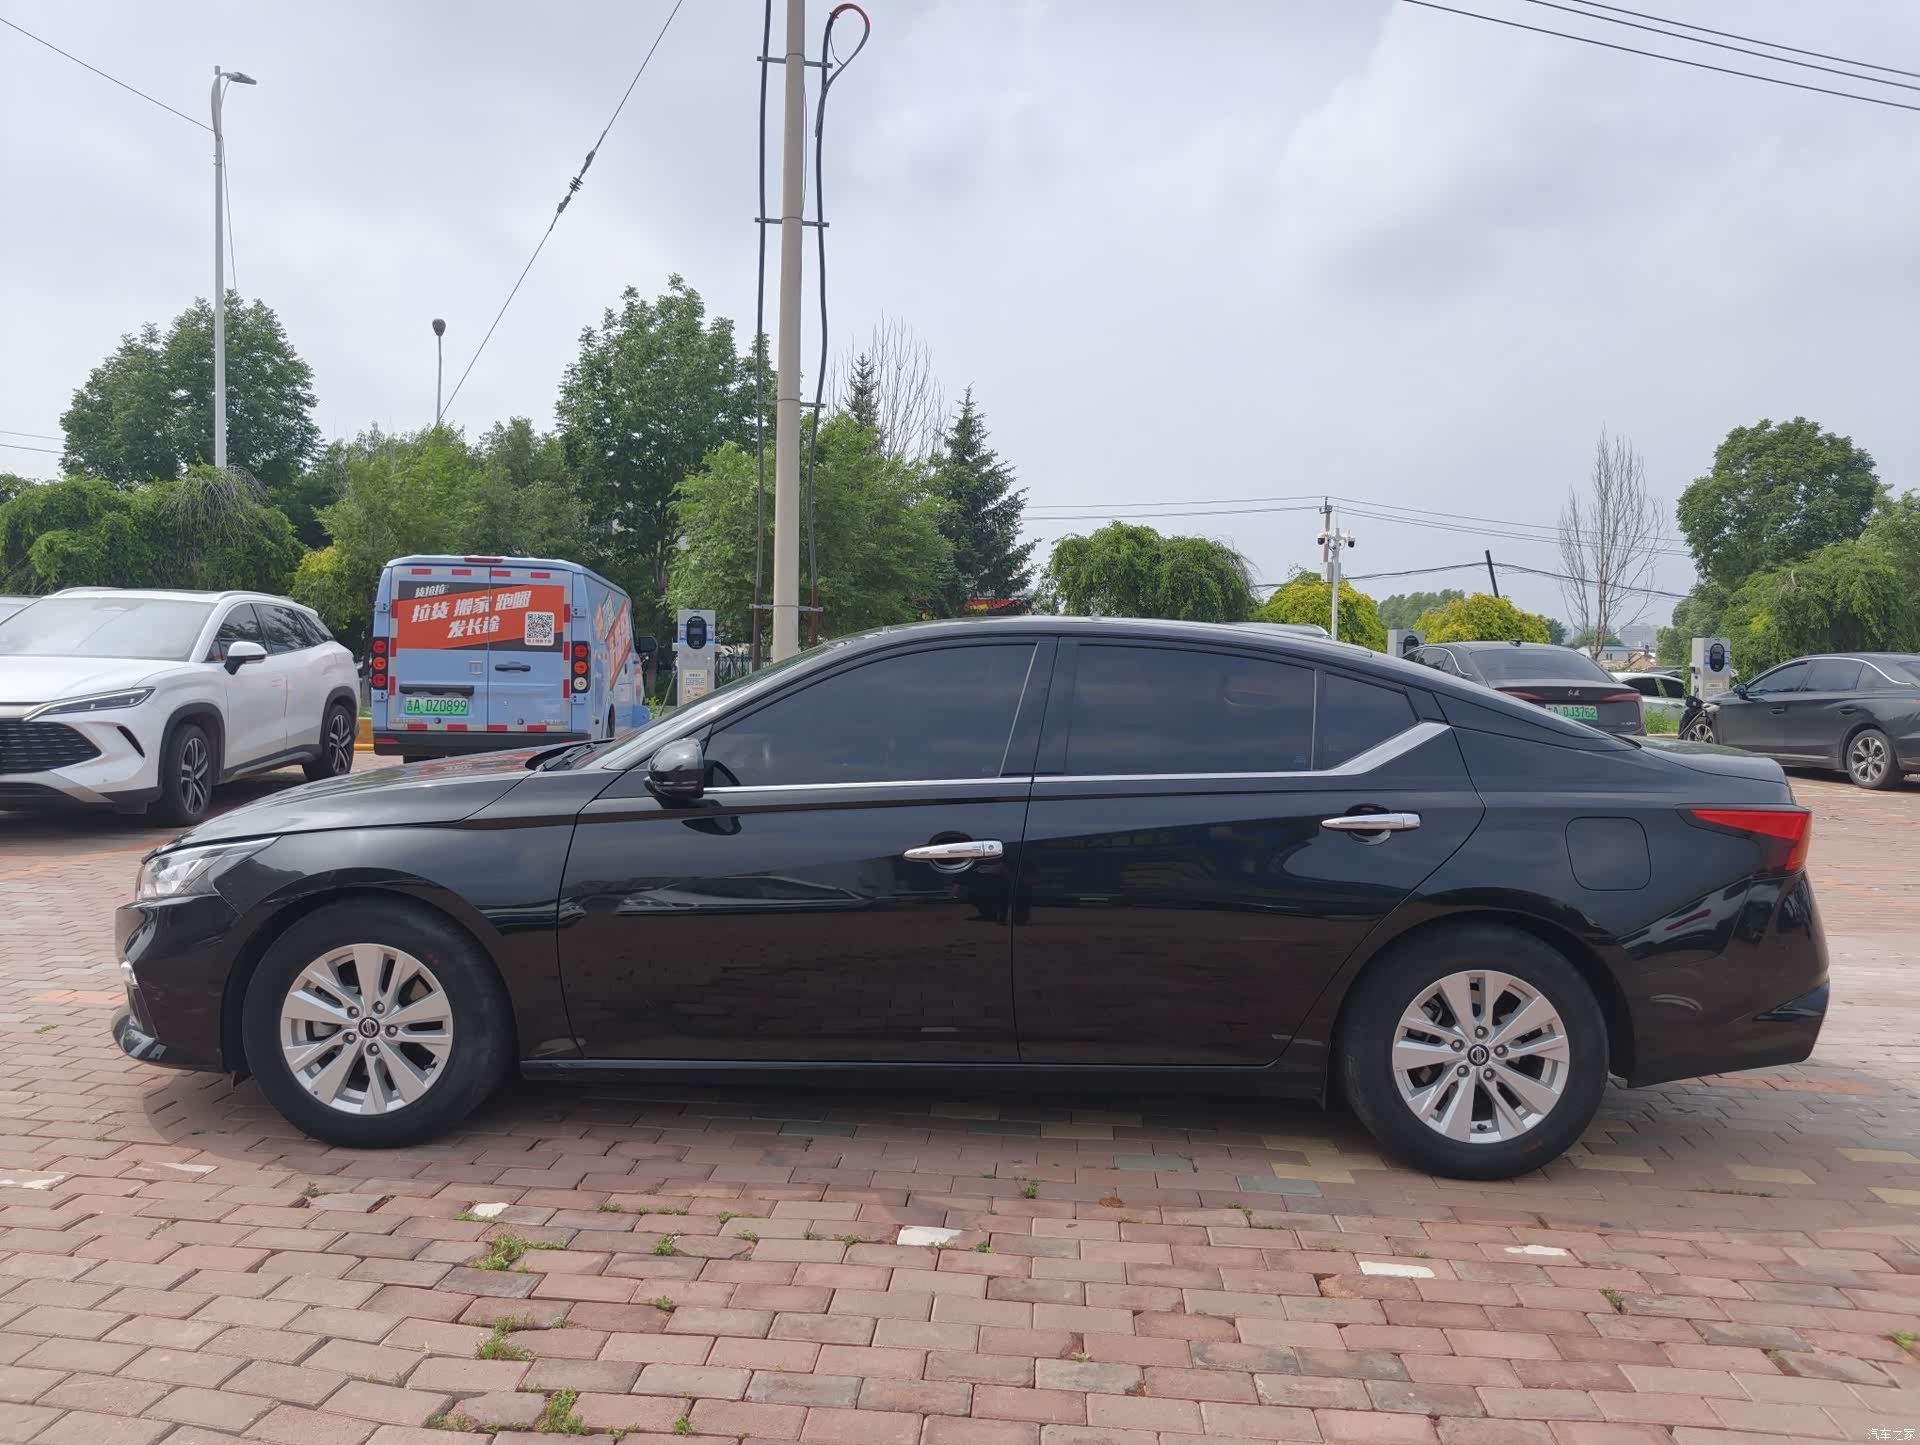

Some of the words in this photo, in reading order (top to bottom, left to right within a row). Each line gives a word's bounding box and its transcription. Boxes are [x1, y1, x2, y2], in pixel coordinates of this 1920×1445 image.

[411, 602, 450, 623] 拉货
[453, 596, 493, 617] 搬家
[495, 590, 532, 611] 跑腿
[448, 615, 500, 639] 发长途
